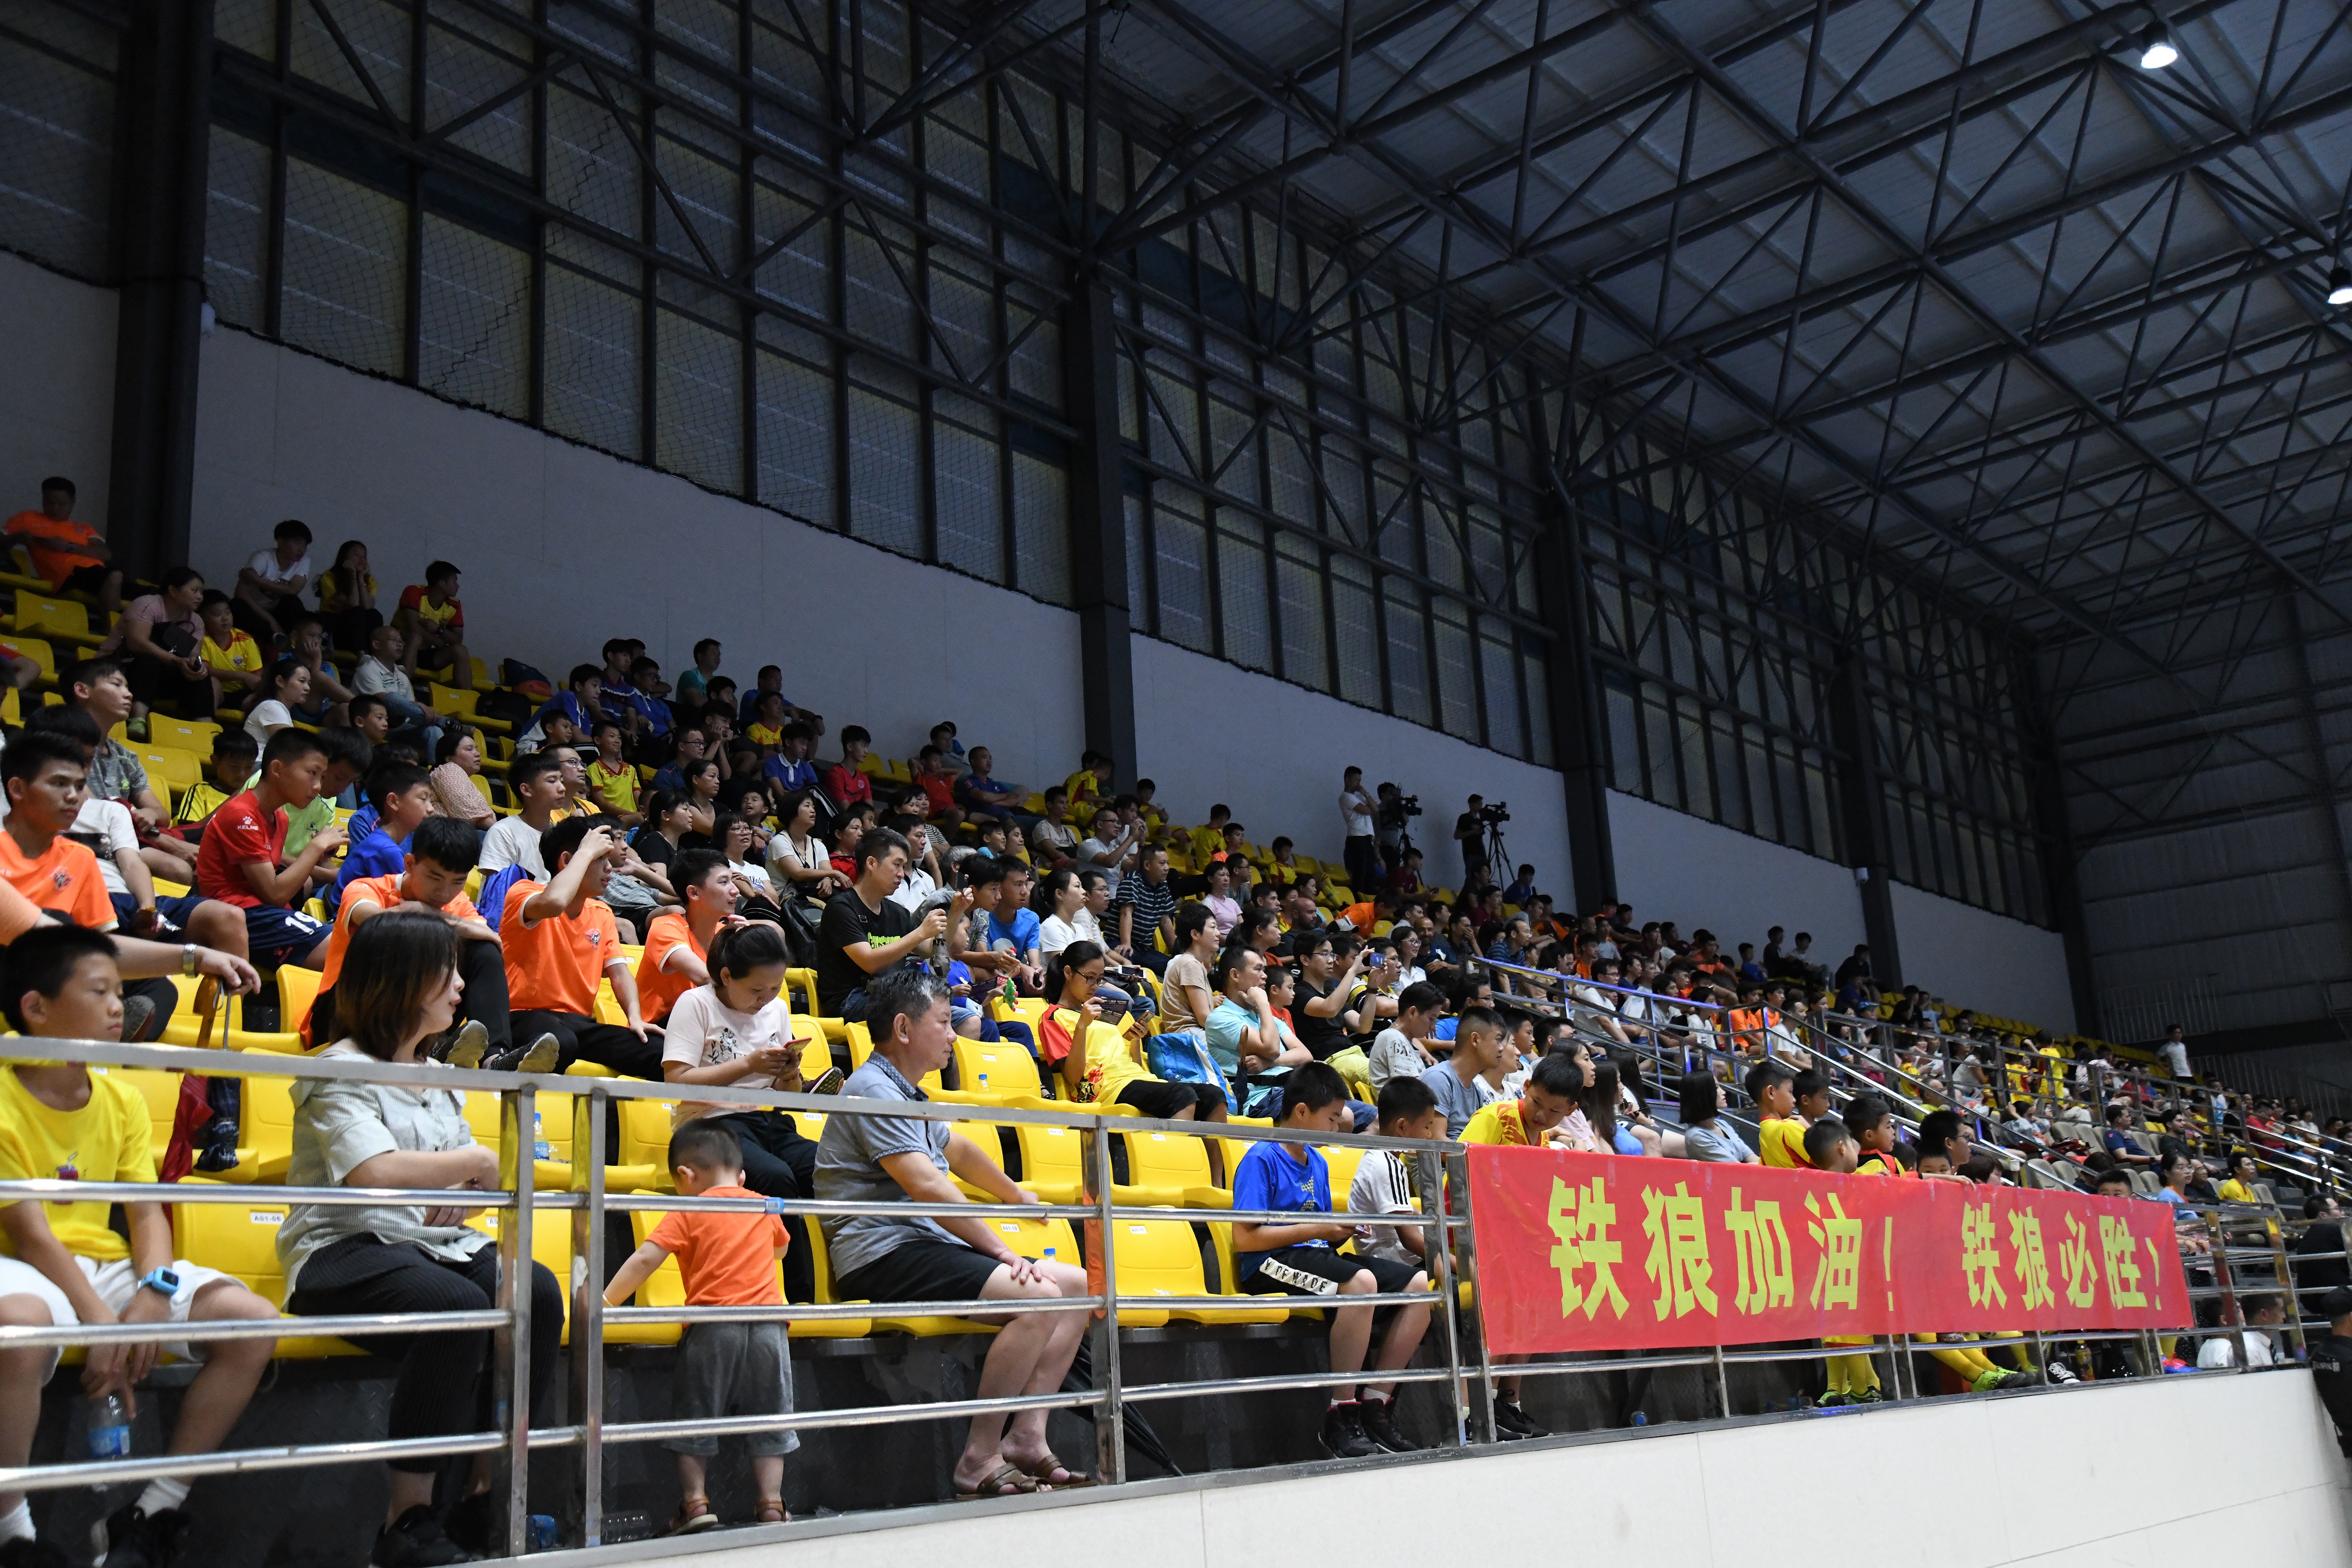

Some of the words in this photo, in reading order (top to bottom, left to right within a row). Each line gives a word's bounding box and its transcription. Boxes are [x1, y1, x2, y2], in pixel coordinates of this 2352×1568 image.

[285, 911, 323, 935] 19
[1548, 1175, 1894, 1322] 铁狼加油！
[1962, 1201, 2162, 1311] 铁狼必胜！
[1292, 1271, 1327, 1292] WADE
